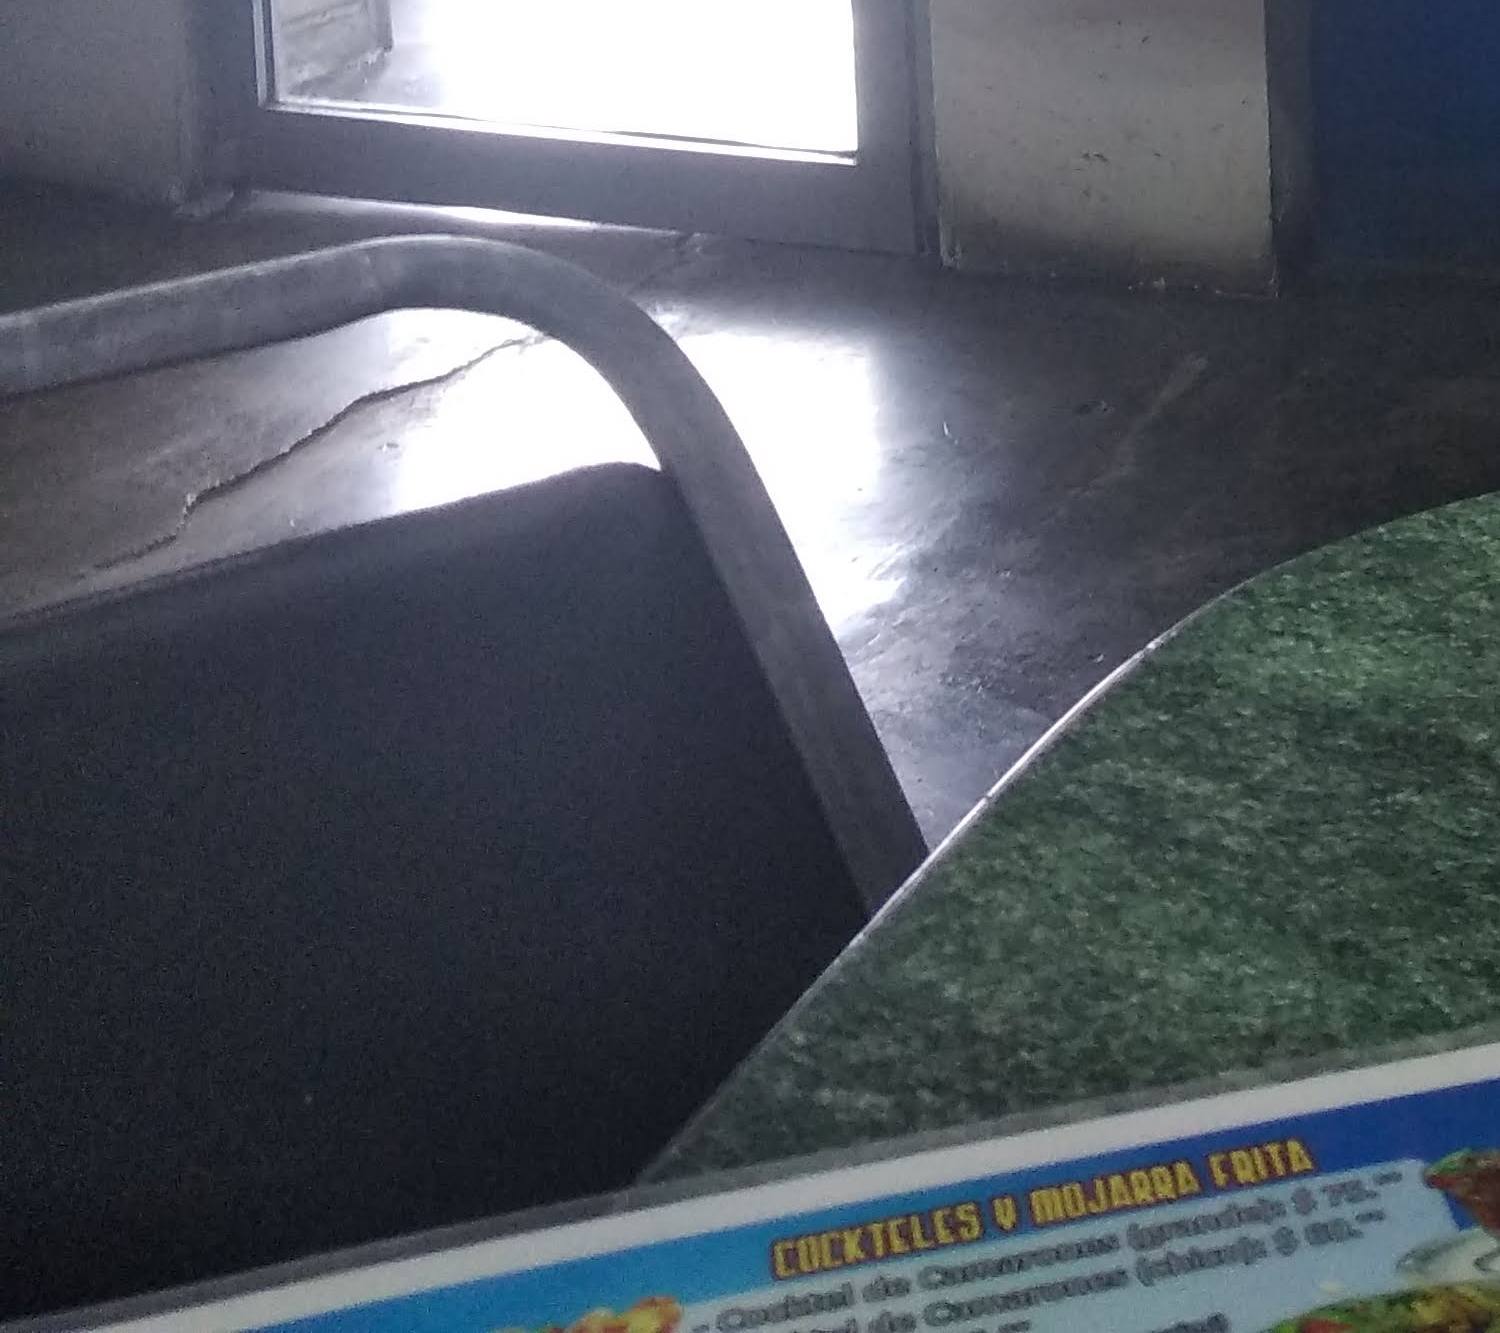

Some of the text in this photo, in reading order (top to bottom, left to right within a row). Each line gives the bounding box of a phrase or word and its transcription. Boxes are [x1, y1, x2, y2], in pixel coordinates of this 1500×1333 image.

[772, 1200, 984, 1280] COCKTELES
[1027, 1159, 1203, 1227] MOJARRA
[1206, 1137, 1316, 1190] FRITA
